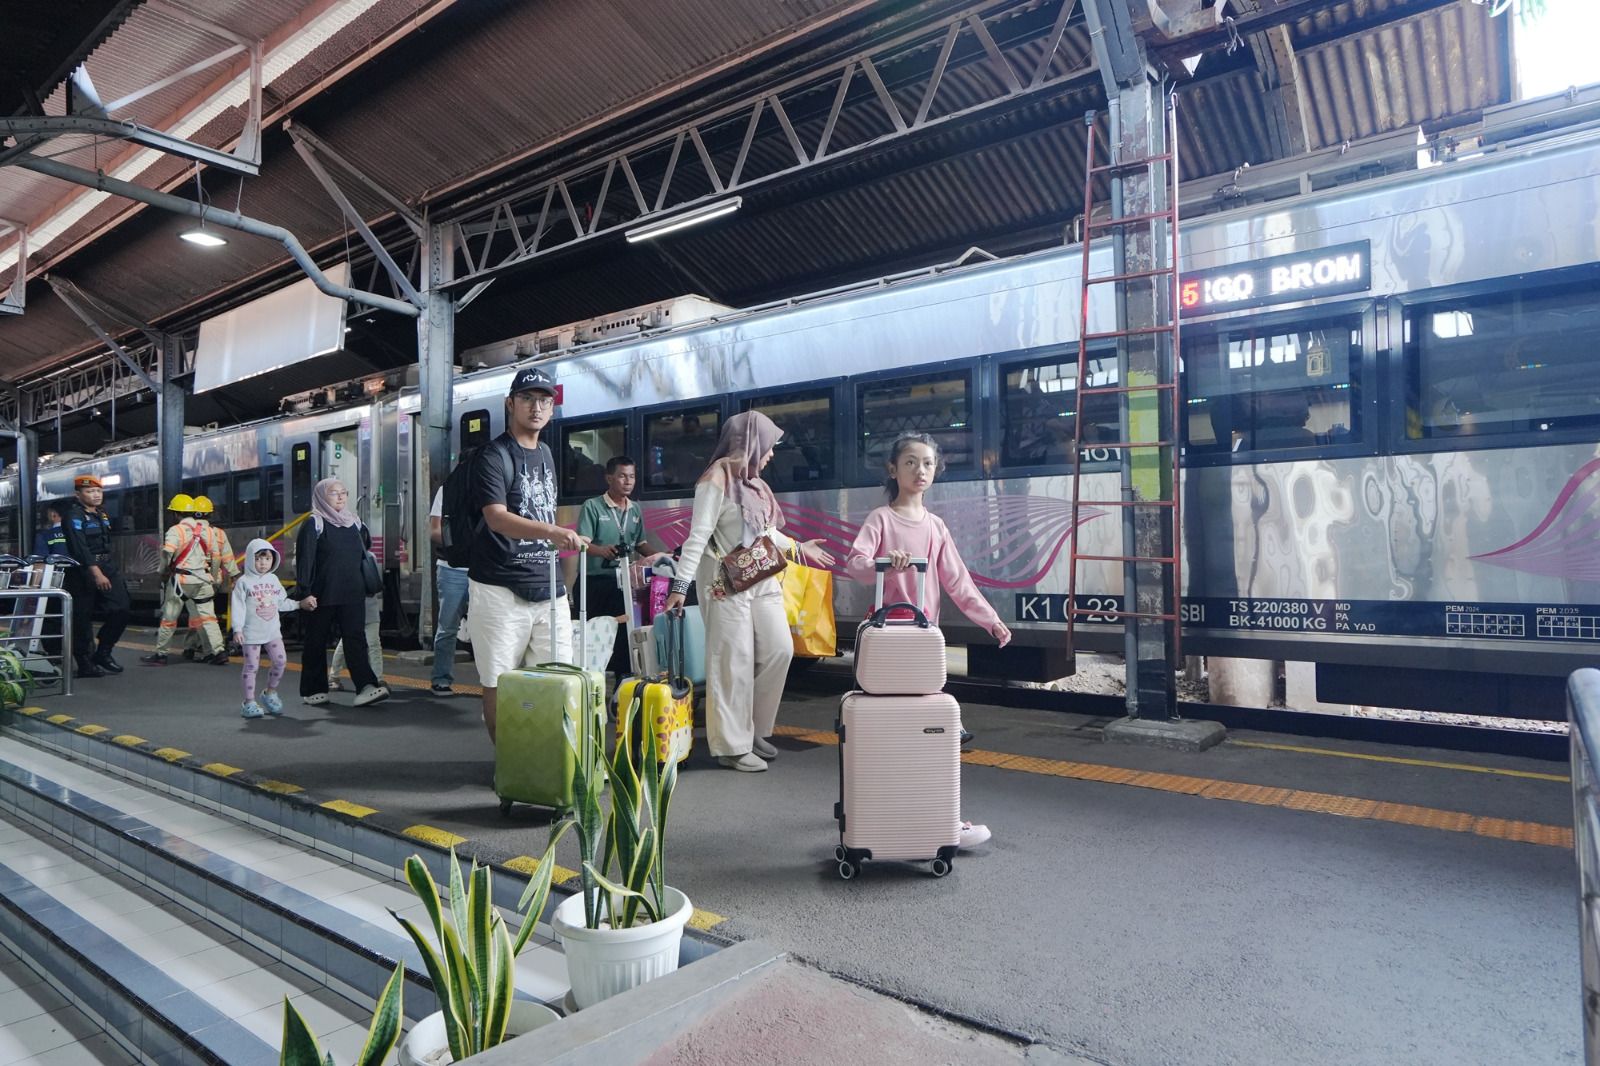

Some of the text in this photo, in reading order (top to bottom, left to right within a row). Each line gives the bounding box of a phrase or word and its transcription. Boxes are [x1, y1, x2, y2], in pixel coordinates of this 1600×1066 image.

[1182, 282, 1200, 306] 5
[1270, 253, 1361, 292] BROM
[1021, 597, 1051, 620] K1
[1087, 598, 1119, 622] 23
[1229, 601, 1324, 614] TS 220/380 V
[1335, 603, 1350, 611] MD
[1229, 615, 1327, 630] BK-41000 KG
[1335, 613, 1349, 621] PA
[1335, 623, 1349, 631] PA
